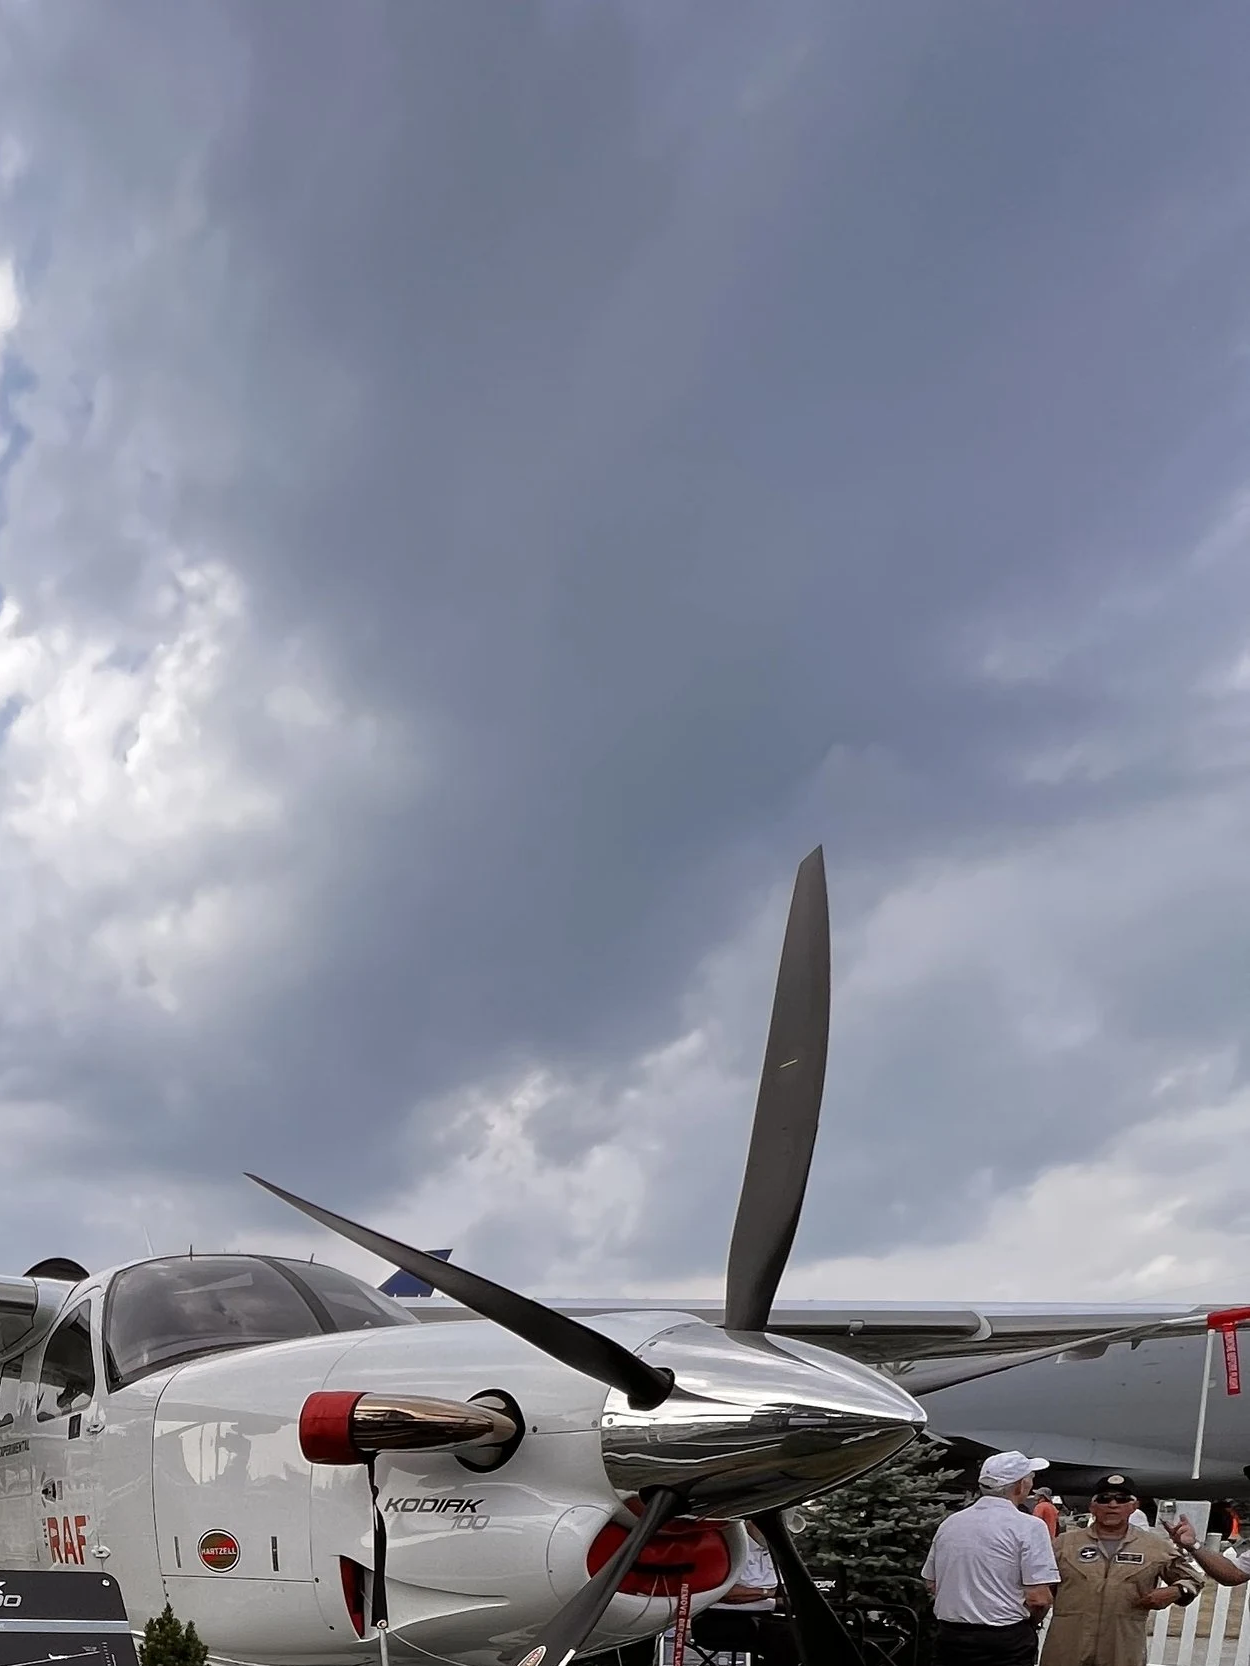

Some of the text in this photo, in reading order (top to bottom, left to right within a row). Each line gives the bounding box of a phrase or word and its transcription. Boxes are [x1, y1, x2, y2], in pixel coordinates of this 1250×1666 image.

[383, 1497, 486, 1514] KODIAK
[450, 1514, 491, 1530] 100
[47, 1515, 87, 1565] RAF
[201, 1547, 237, 1555] HARTZELL
[812, 1579, 836, 1589] ODIAK
[679, 1583, 689, 1615] REMOVE
[676, 1618, 686, 1649] BEFORE
